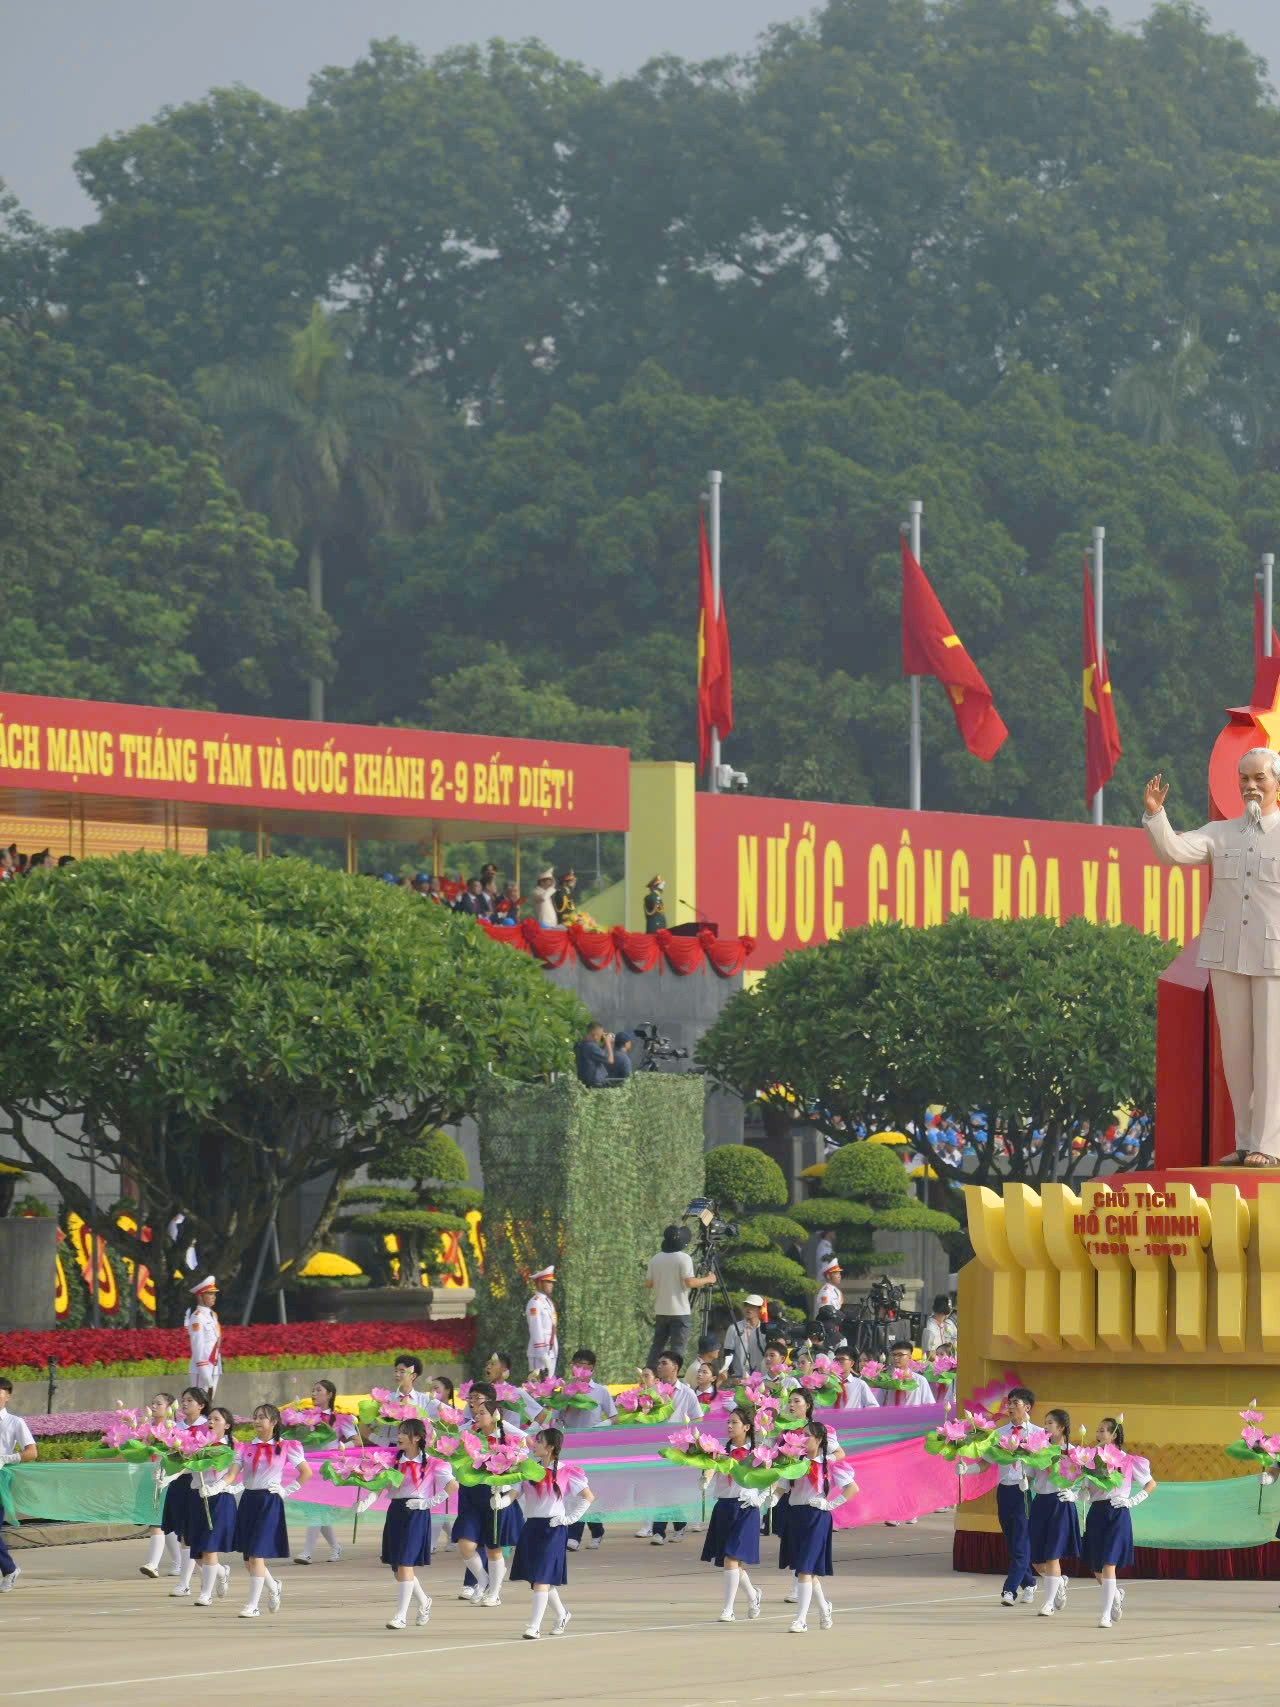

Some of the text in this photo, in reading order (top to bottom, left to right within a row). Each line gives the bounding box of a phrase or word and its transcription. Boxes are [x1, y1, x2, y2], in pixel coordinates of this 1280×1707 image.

[46, 727, 113, 783] MẠNG
[120, 728, 198, 783] THÁNG
[203, 733, 252, 788] TÁM
[256, 737, 287, 790] VÀ
[292, 737, 348, 795] QUỐC
[354, 746, 424, 800] KHÁNH
[430, 761, 468, 804] 2-9
[473, 751, 514, 806] BẤT
[519, 759, 574, 816] DIỆT!
[738, 821, 844, 942] NƯỚC
[992, 839, 1061, 928] HÒA
[1082, 847, 1122, 928] XÃ
[1073, 1206, 1199, 1237] HỒ CHÍ MINH
[1094, 1187, 1176, 1211] CHỦ TỊCH
